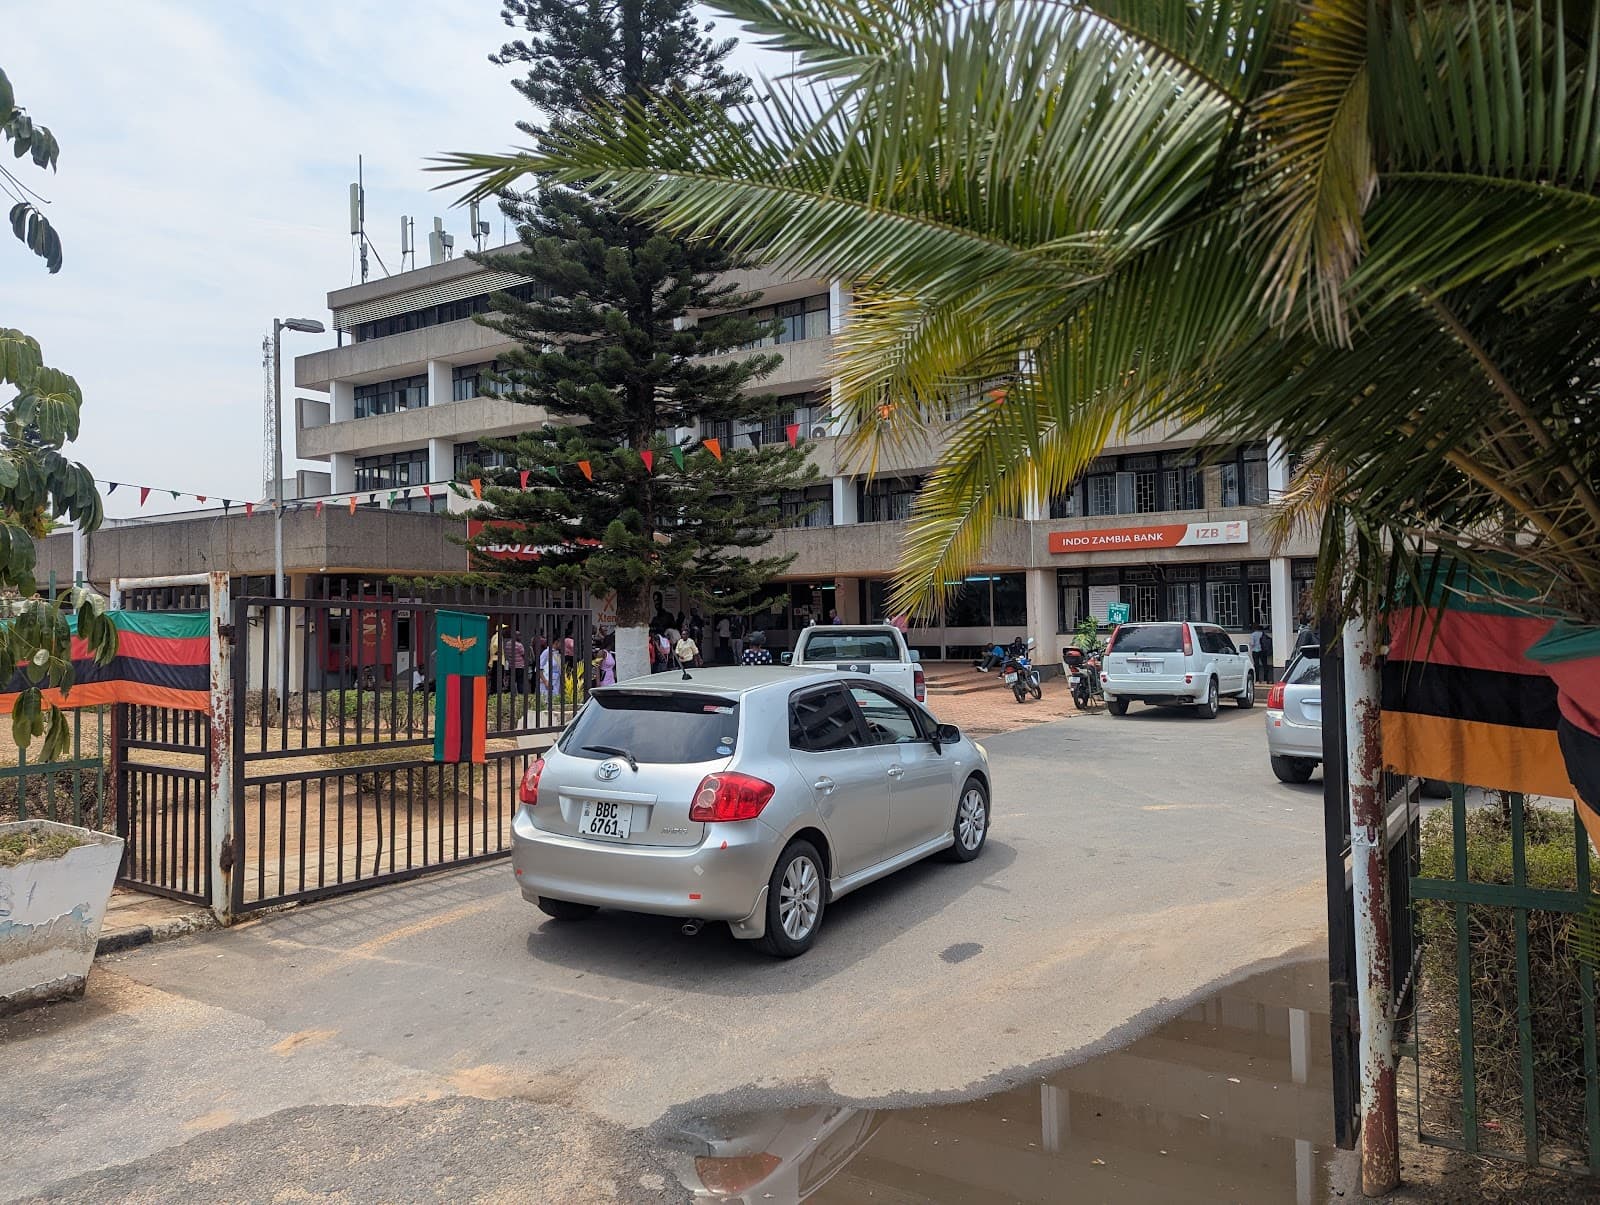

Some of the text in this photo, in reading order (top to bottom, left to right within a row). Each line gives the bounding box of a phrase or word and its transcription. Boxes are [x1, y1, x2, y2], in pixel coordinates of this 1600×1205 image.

[1062, 537, 1090, 546] INDO
[1092, 535, 1131, 545] ZAMBIA
[1134, 532, 1164, 543] BANK
[1196, 528, 1219, 539] IZB
[598, 612, 617, 622] Xten
[595, 802, 618, 818] BBC
[590, 818, 618, 835] 6761
